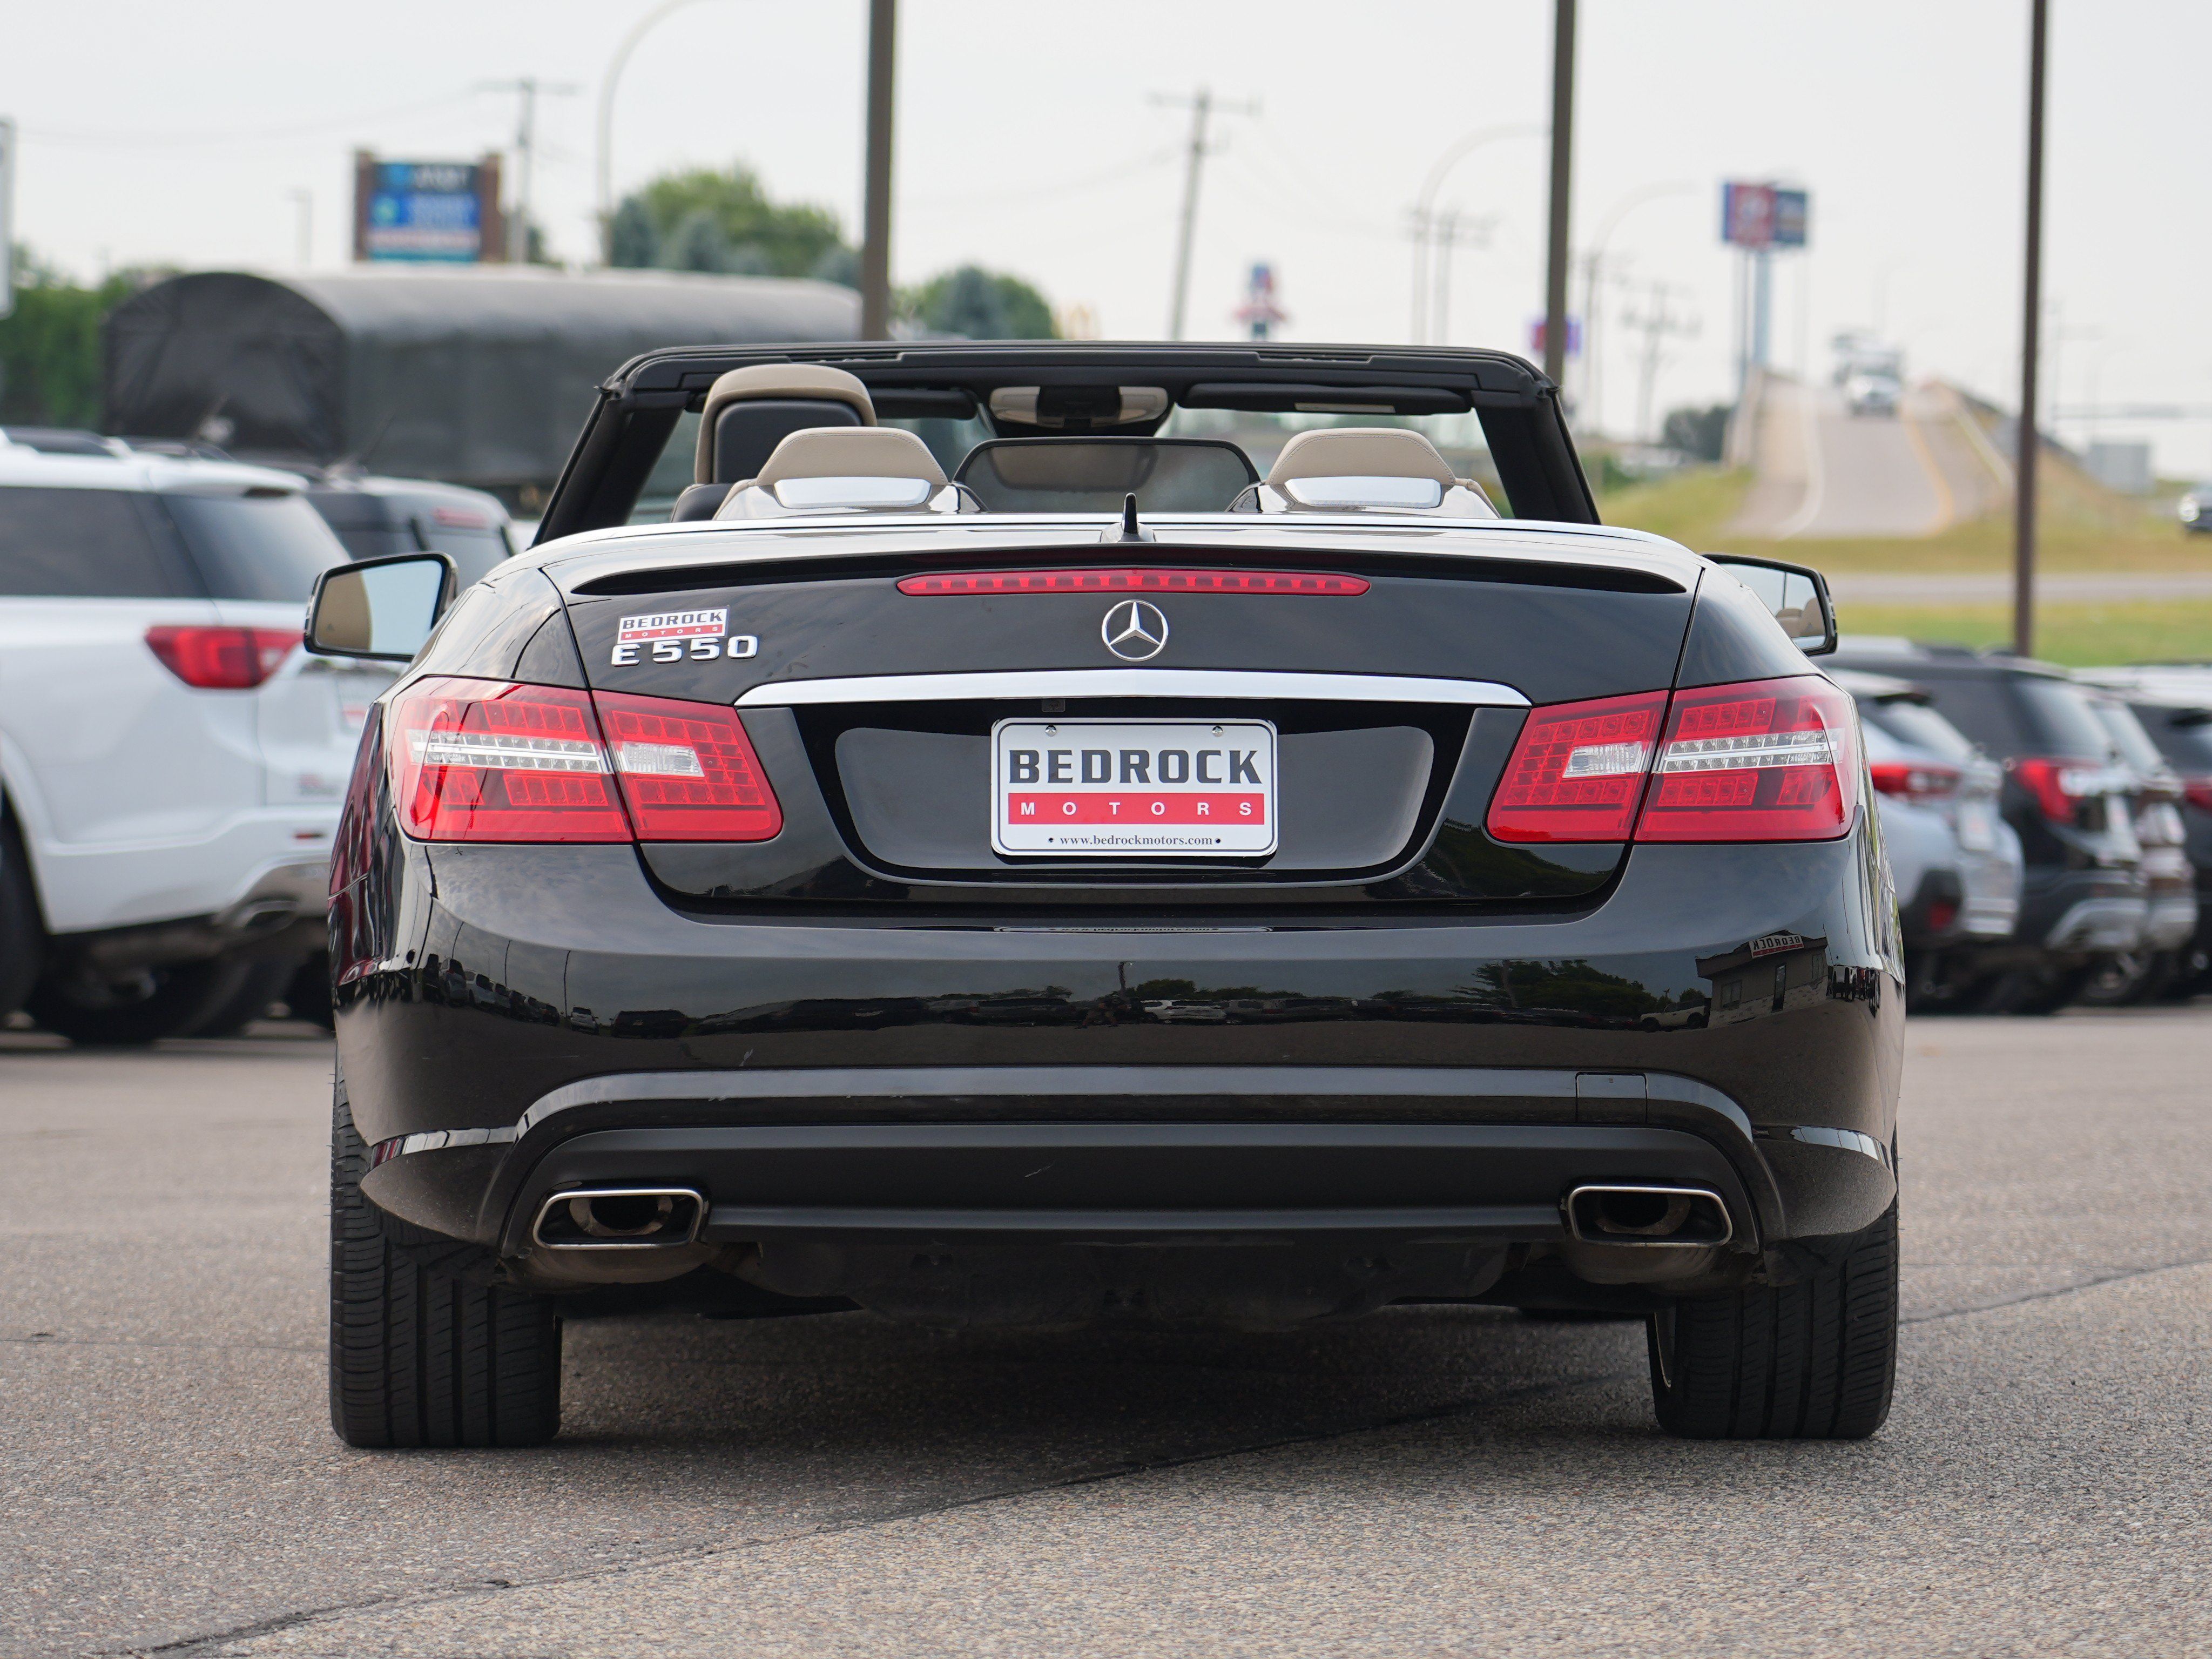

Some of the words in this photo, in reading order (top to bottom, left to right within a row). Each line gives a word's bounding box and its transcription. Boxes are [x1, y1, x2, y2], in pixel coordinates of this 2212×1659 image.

[623, 611, 722, 629] BEDROCK
[625, 626, 718, 638] MOTORS
[1009, 750, 1263, 784] BEDROCK
[1021, 802, 1252, 815] MOTORS
[1060, 834, 1213, 845] www.bedrockmotors.com
